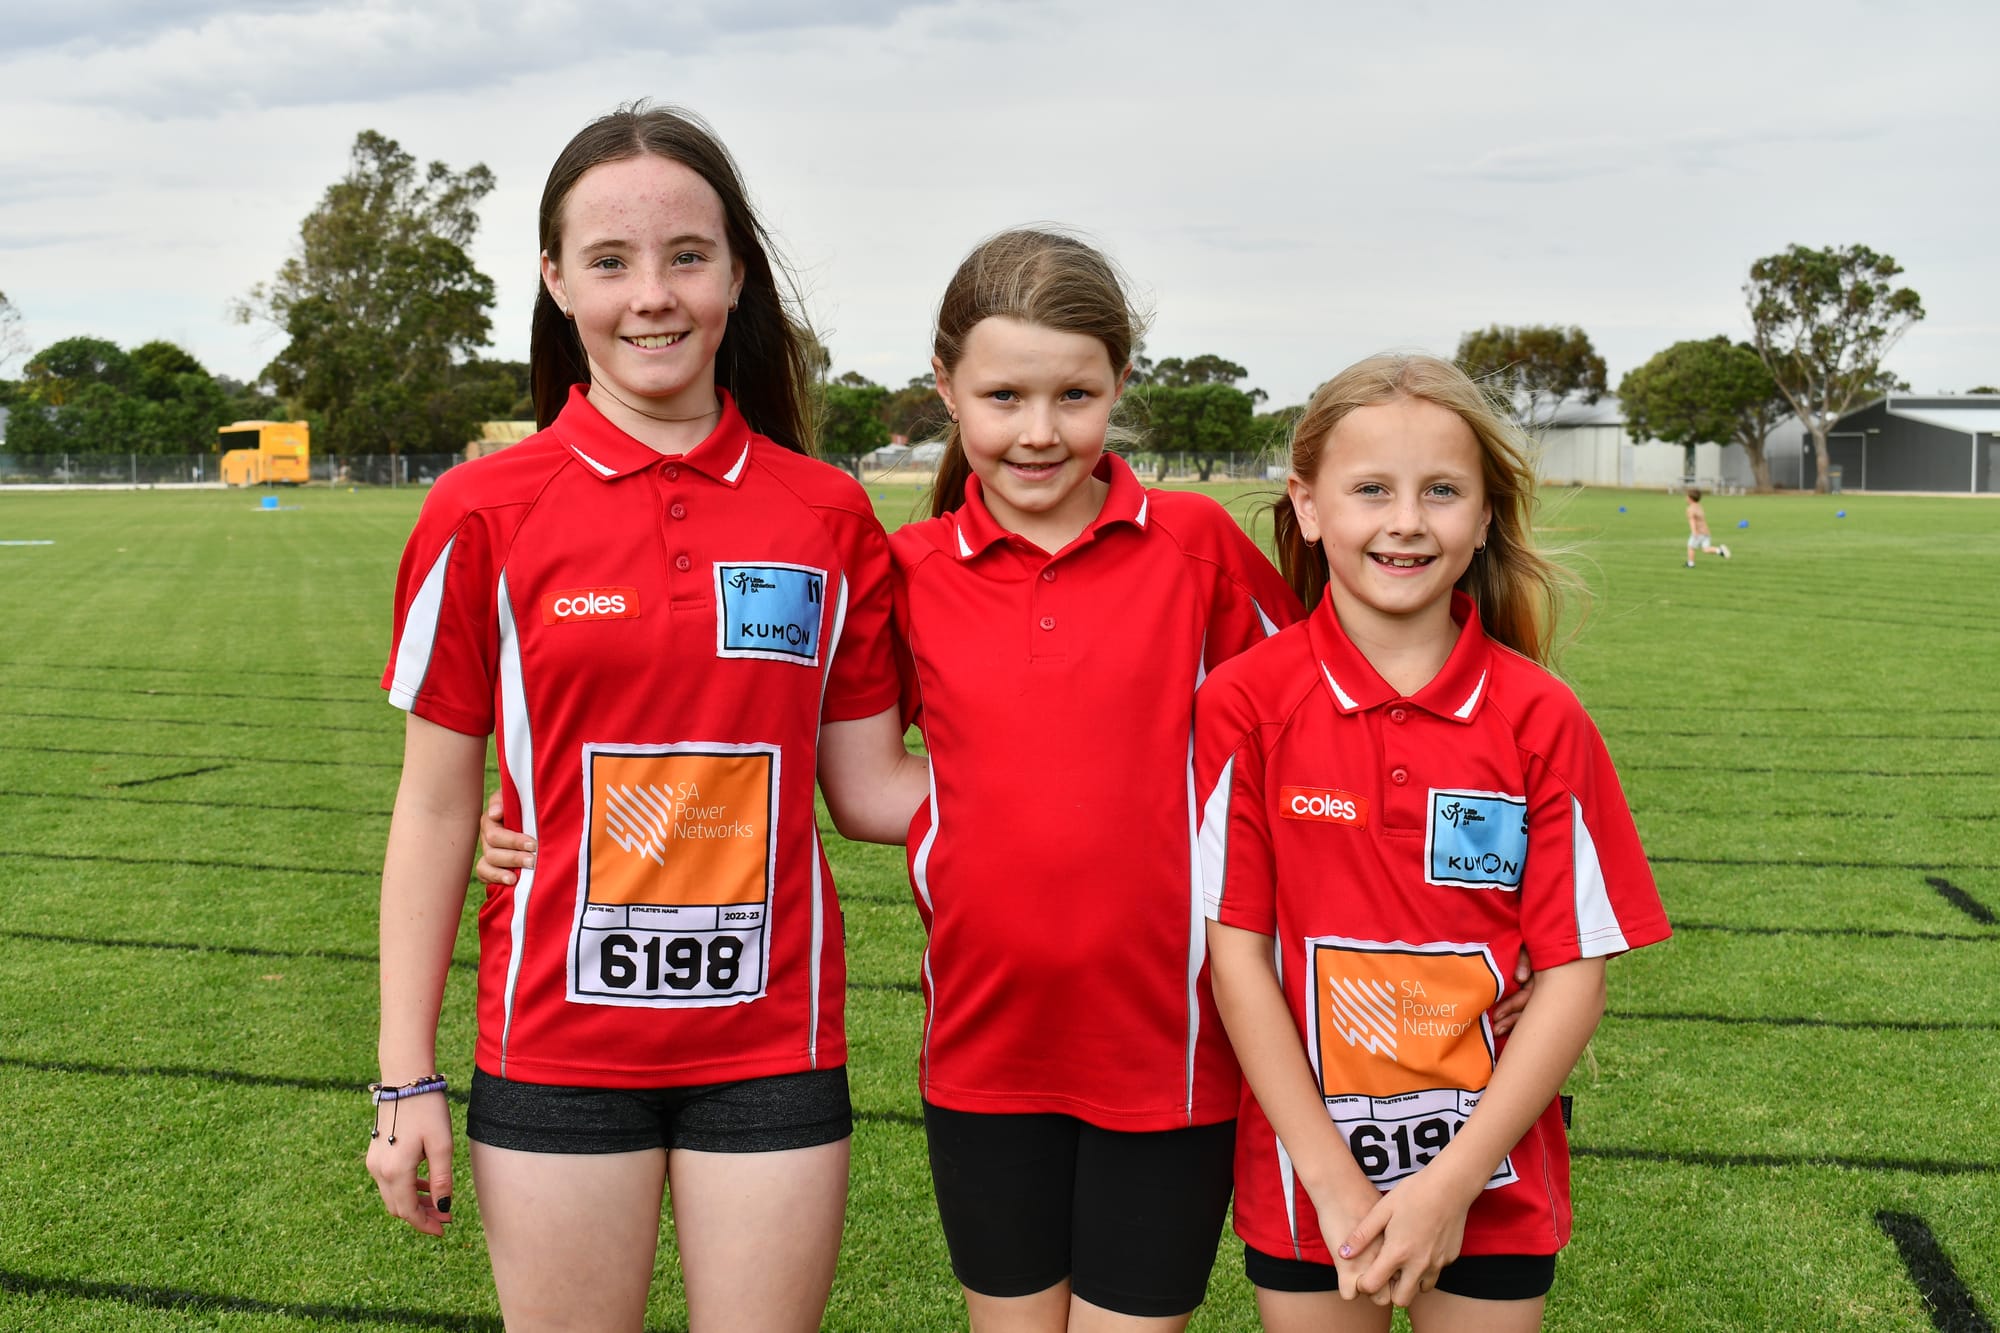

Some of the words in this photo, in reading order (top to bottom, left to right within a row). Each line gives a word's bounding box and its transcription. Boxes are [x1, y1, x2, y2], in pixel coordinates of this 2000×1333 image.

[808, 579, 820, 604] 11
[553, 592, 626, 617] coles
[741, 623, 810, 646] KUMON
[676, 782, 699, 800] SA
[674, 803, 727, 820] Power
[1291, 794, 1357, 820] coles
[673, 821, 754, 840] Networks
[1448, 853, 1518, 876] KUMON
[724, 911, 760, 921] 2022-23
[600, 934, 744, 991] 6198
[1401, 981, 1427, 998] SA
[1402, 1000, 1457, 1017] Power
